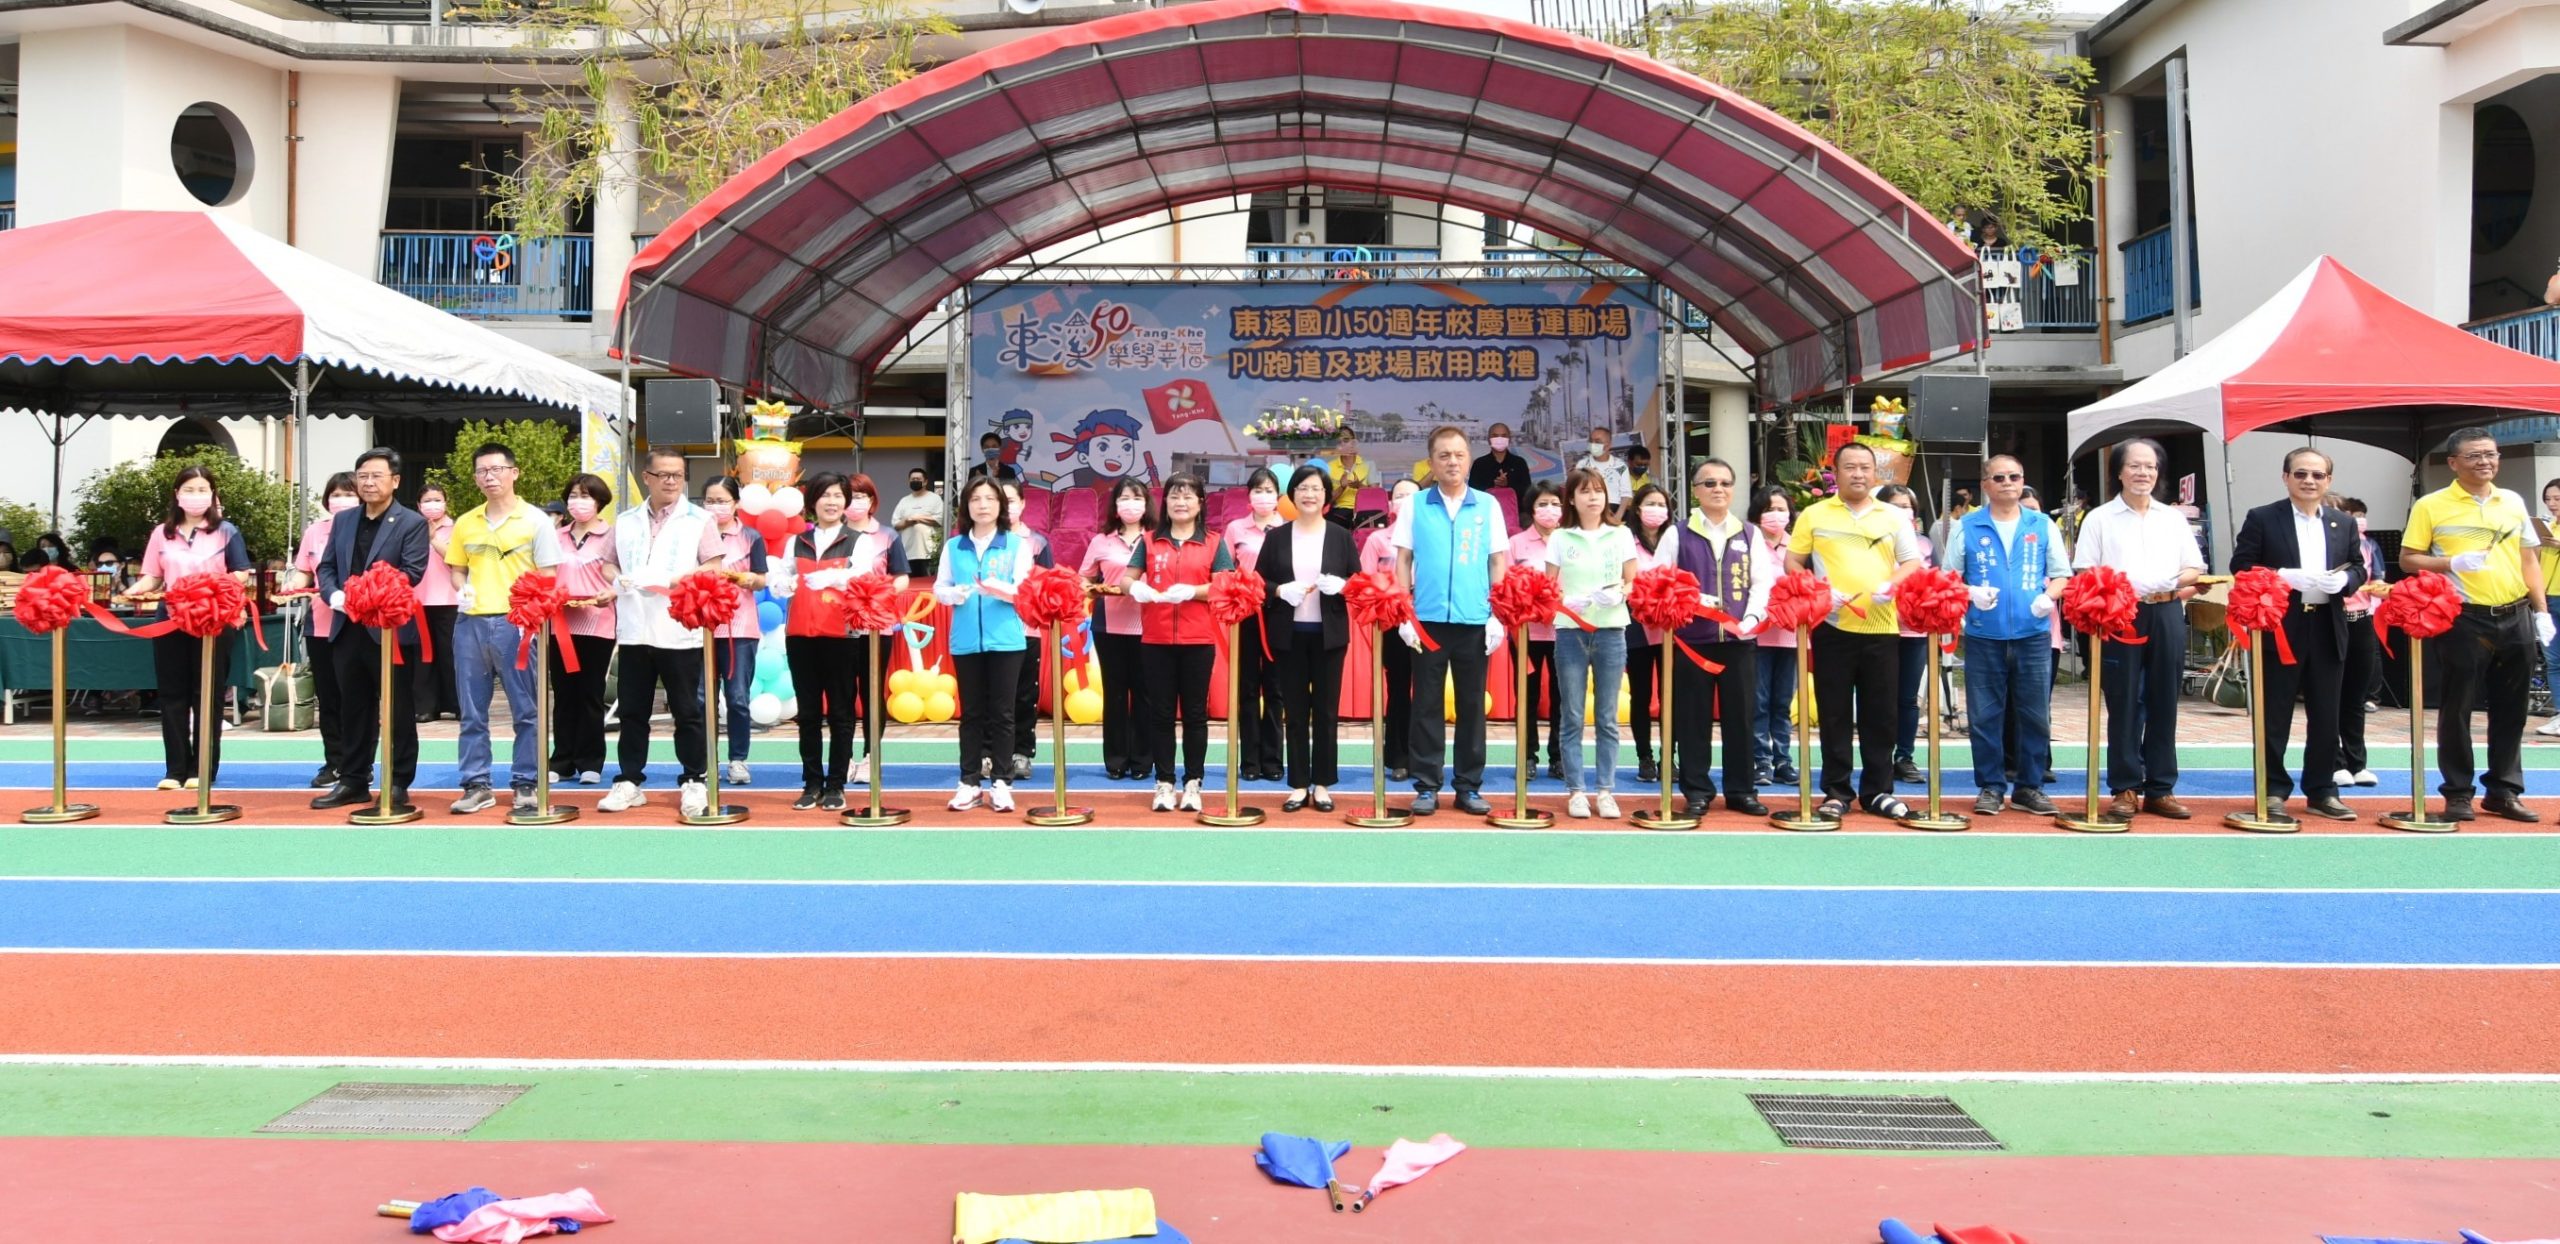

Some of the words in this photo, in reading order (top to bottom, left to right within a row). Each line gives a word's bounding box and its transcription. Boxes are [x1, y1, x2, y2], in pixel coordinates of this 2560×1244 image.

[1089, 302, 1129, 356] 50
[1135, 328, 1204, 340] Tang-Khe
[1232, 308, 1627, 338] 東溪國小50週年校慶暨運動場
[1108, 341, 1204, 369] 樂學幸福
[1232, 349, 1536, 378] PU跑道及球場啟用典禮
[1171, 408, 1205, 420] Tang-Khe
[2180, 475, 2193, 503] 50
